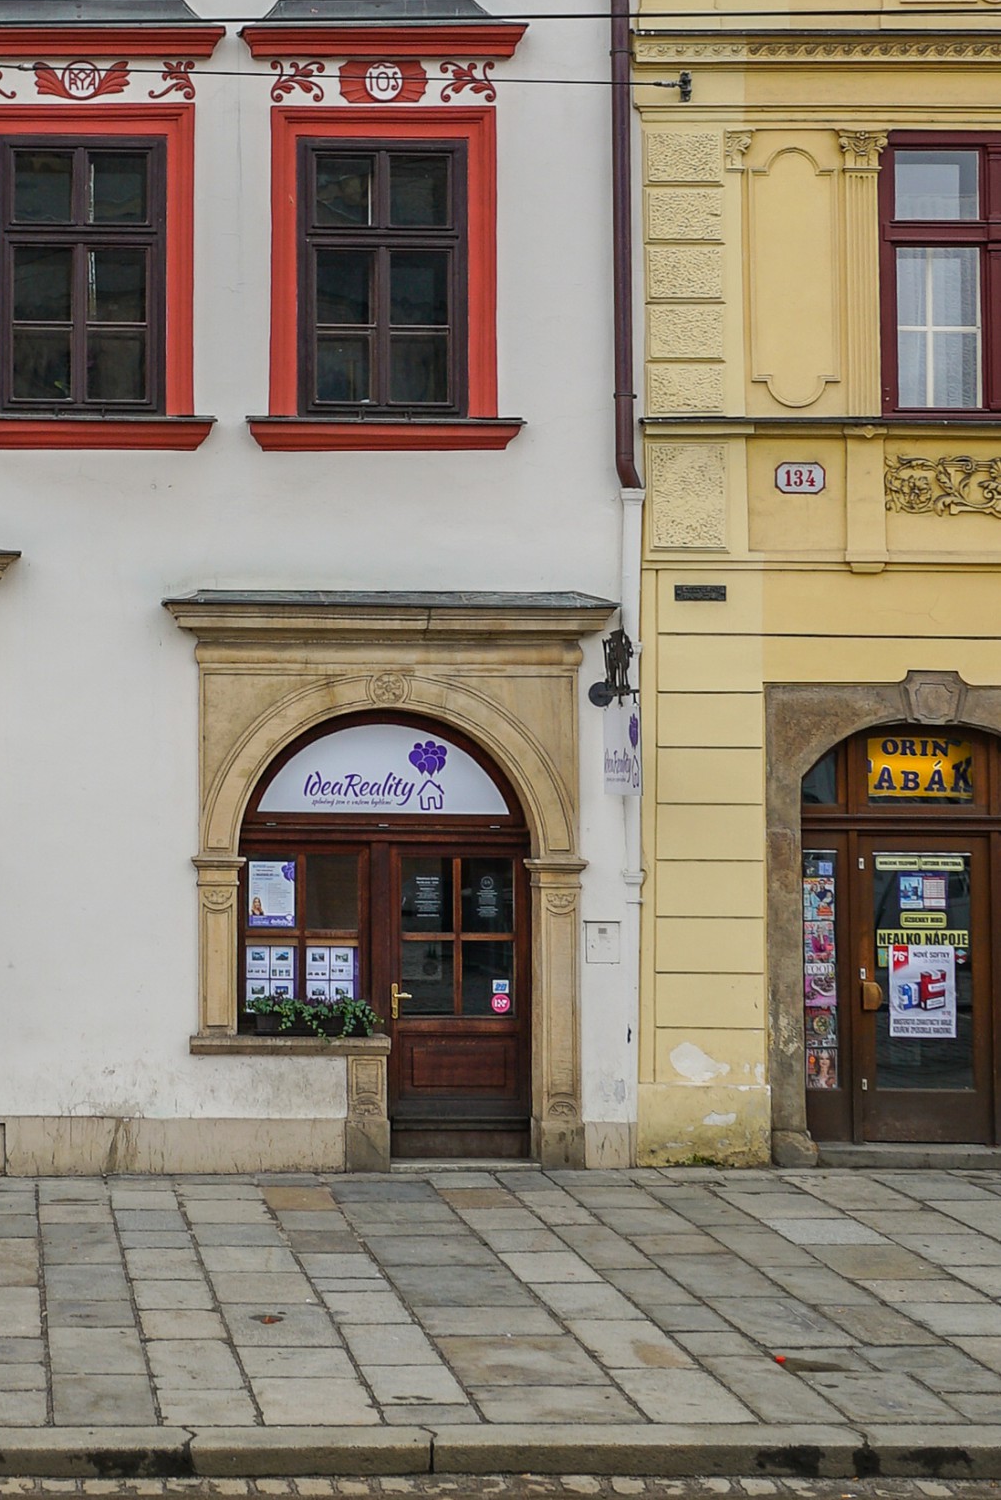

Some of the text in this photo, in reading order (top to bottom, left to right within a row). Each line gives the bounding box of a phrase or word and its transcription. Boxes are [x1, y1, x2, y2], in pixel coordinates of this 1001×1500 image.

[785, 469, 816, 487] 134
[878, 930, 969, 946] NEALKO NÁPOJE
